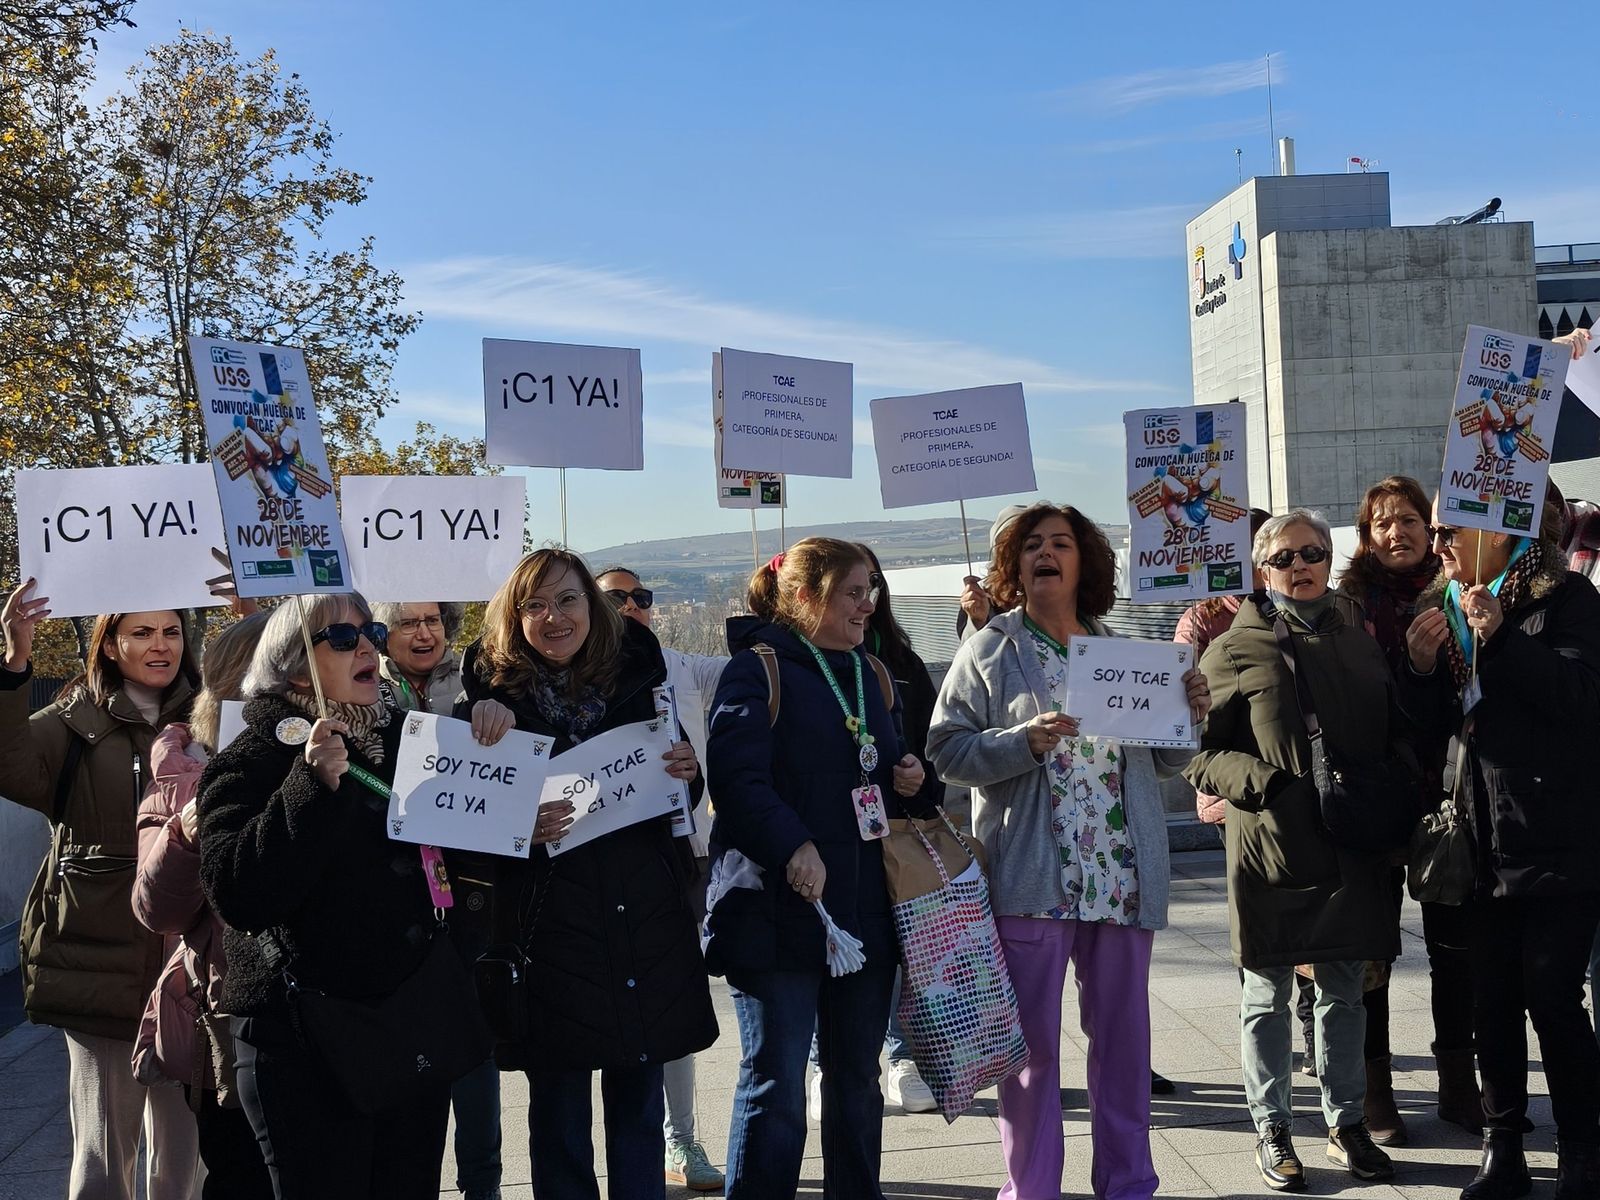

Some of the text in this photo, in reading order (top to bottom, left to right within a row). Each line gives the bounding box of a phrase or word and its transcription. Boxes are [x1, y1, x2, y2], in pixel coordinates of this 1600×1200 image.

[1481, 350, 1511, 369] USO
[213, 366, 251, 388] USO
[773, 375, 795, 387] TCAE
[1467, 375, 1552, 400] CONVOCAN HUELGA DE
[502, 372, 619, 409] ¡C1 YA!
[742, 390, 827, 408] ¡PROFESIONALES DE
[1500, 394, 1517, 406] TCAE
[211, 399, 306, 420] CONVOCAN HUELGA DE
[764, 409, 804, 422] PRIMERA,
[933, 409, 958, 420] TCAE
[255, 420, 274, 433] TCAE
[732, 423, 779, 437] CATEGORÍA
[781, 428, 793, 438] DE
[794, 430, 837, 442] SEGUNDA!
[900, 422, 997, 443] ¡PROFESIONALES DE
[1144, 429, 1180, 445] USO
[928, 440, 974, 453] PRIMERA,
[892, 452, 1013, 474] CATEGORÍA DE SEGUNDA!
[1135, 450, 1234, 468] CONVOCAN HUELGA DE
[1474, 455, 1517, 475] 28 DE
[1176, 465, 1196, 477] TCAE
[1451, 470, 1534, 500] NOVIEMBRE
[259, 500, 304, 521] 28 DE
[42, 500, 198, 552] ¡C1 YA!
[363, 508, 499, 548] ¡C1 YA!
[1163, 526, 1211, 547] 28 DE
[238, 525, 331, 549] NOVIEMBRE
[1139, 543, 1235, 567] NOVIEMBRE
[1093, 668, 1170, 686] SOY TCAE
[1107, 696, 1150, 710] C1 YA
[423, 754, 517, 785] SOY TCAE
[562, 748, 646, 800] SOY TCAE
[435, 792, 486, 814] C1 YA
[588, 783, 635, 814] C1 YA
